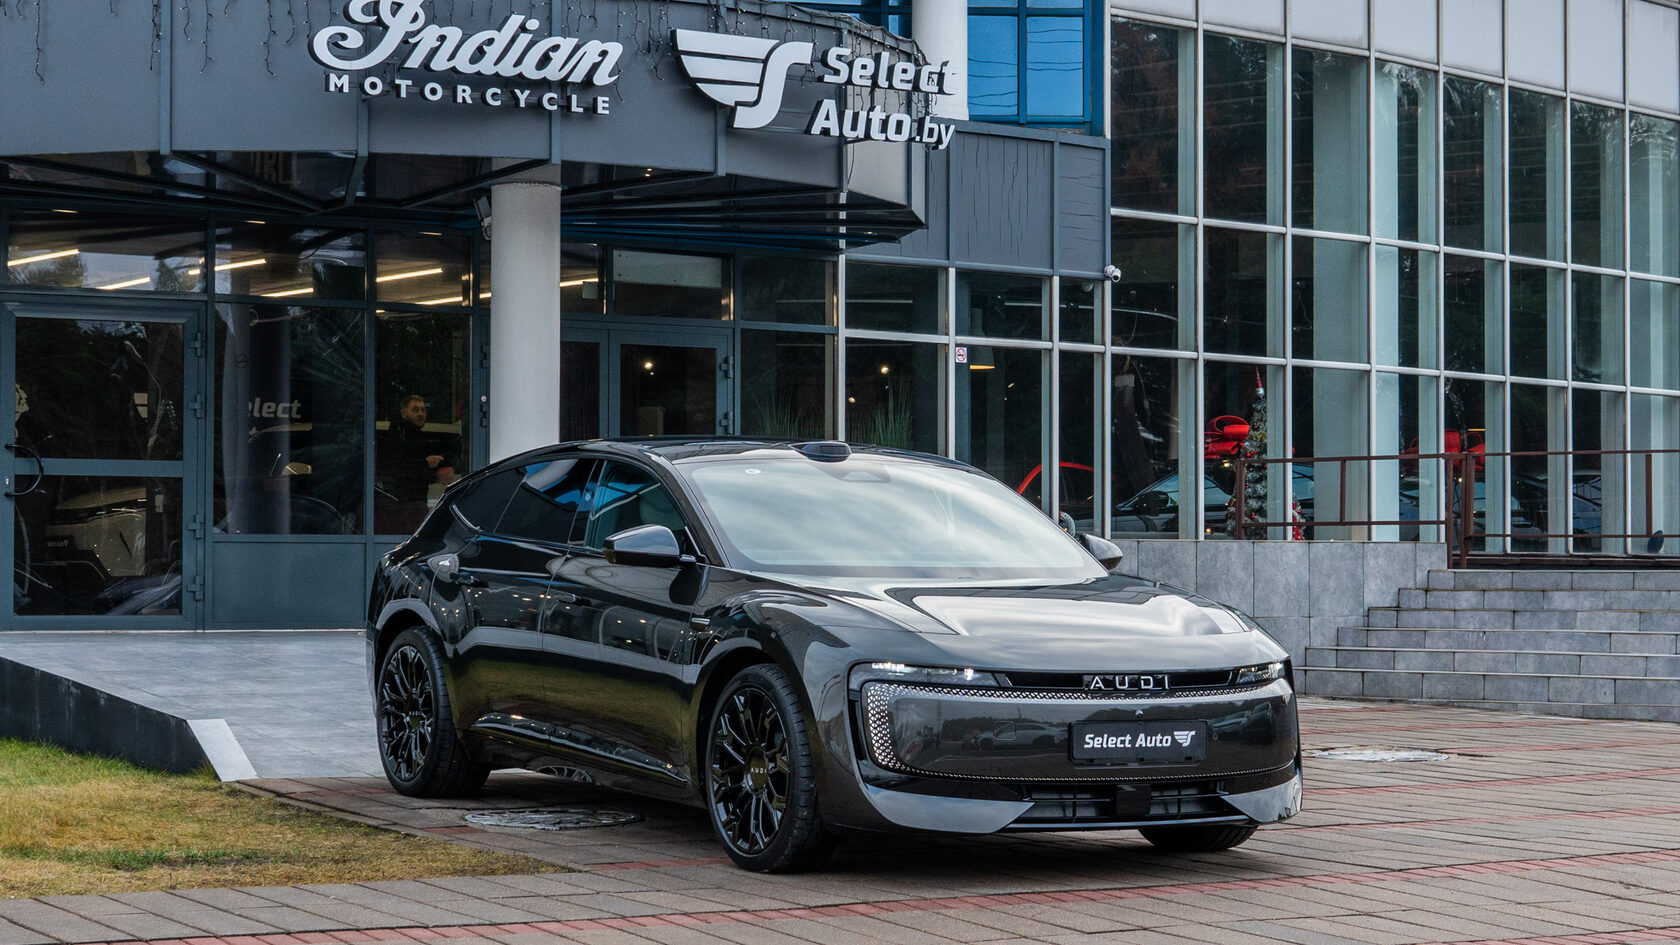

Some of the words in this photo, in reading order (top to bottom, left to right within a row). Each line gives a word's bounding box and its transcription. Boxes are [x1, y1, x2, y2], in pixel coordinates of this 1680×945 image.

[310, 0, 623, 86] Indian
[823, 47, 958, 93] Select
[327, 73, 610, 115] MOTORCYCLE
[809, 99, 955, 150] Auto.by
[1090, 676, 1169, 690] AUDI
[1084, 733, 1132, 748] Select
[1135, 733, 1172, 747] Auto
